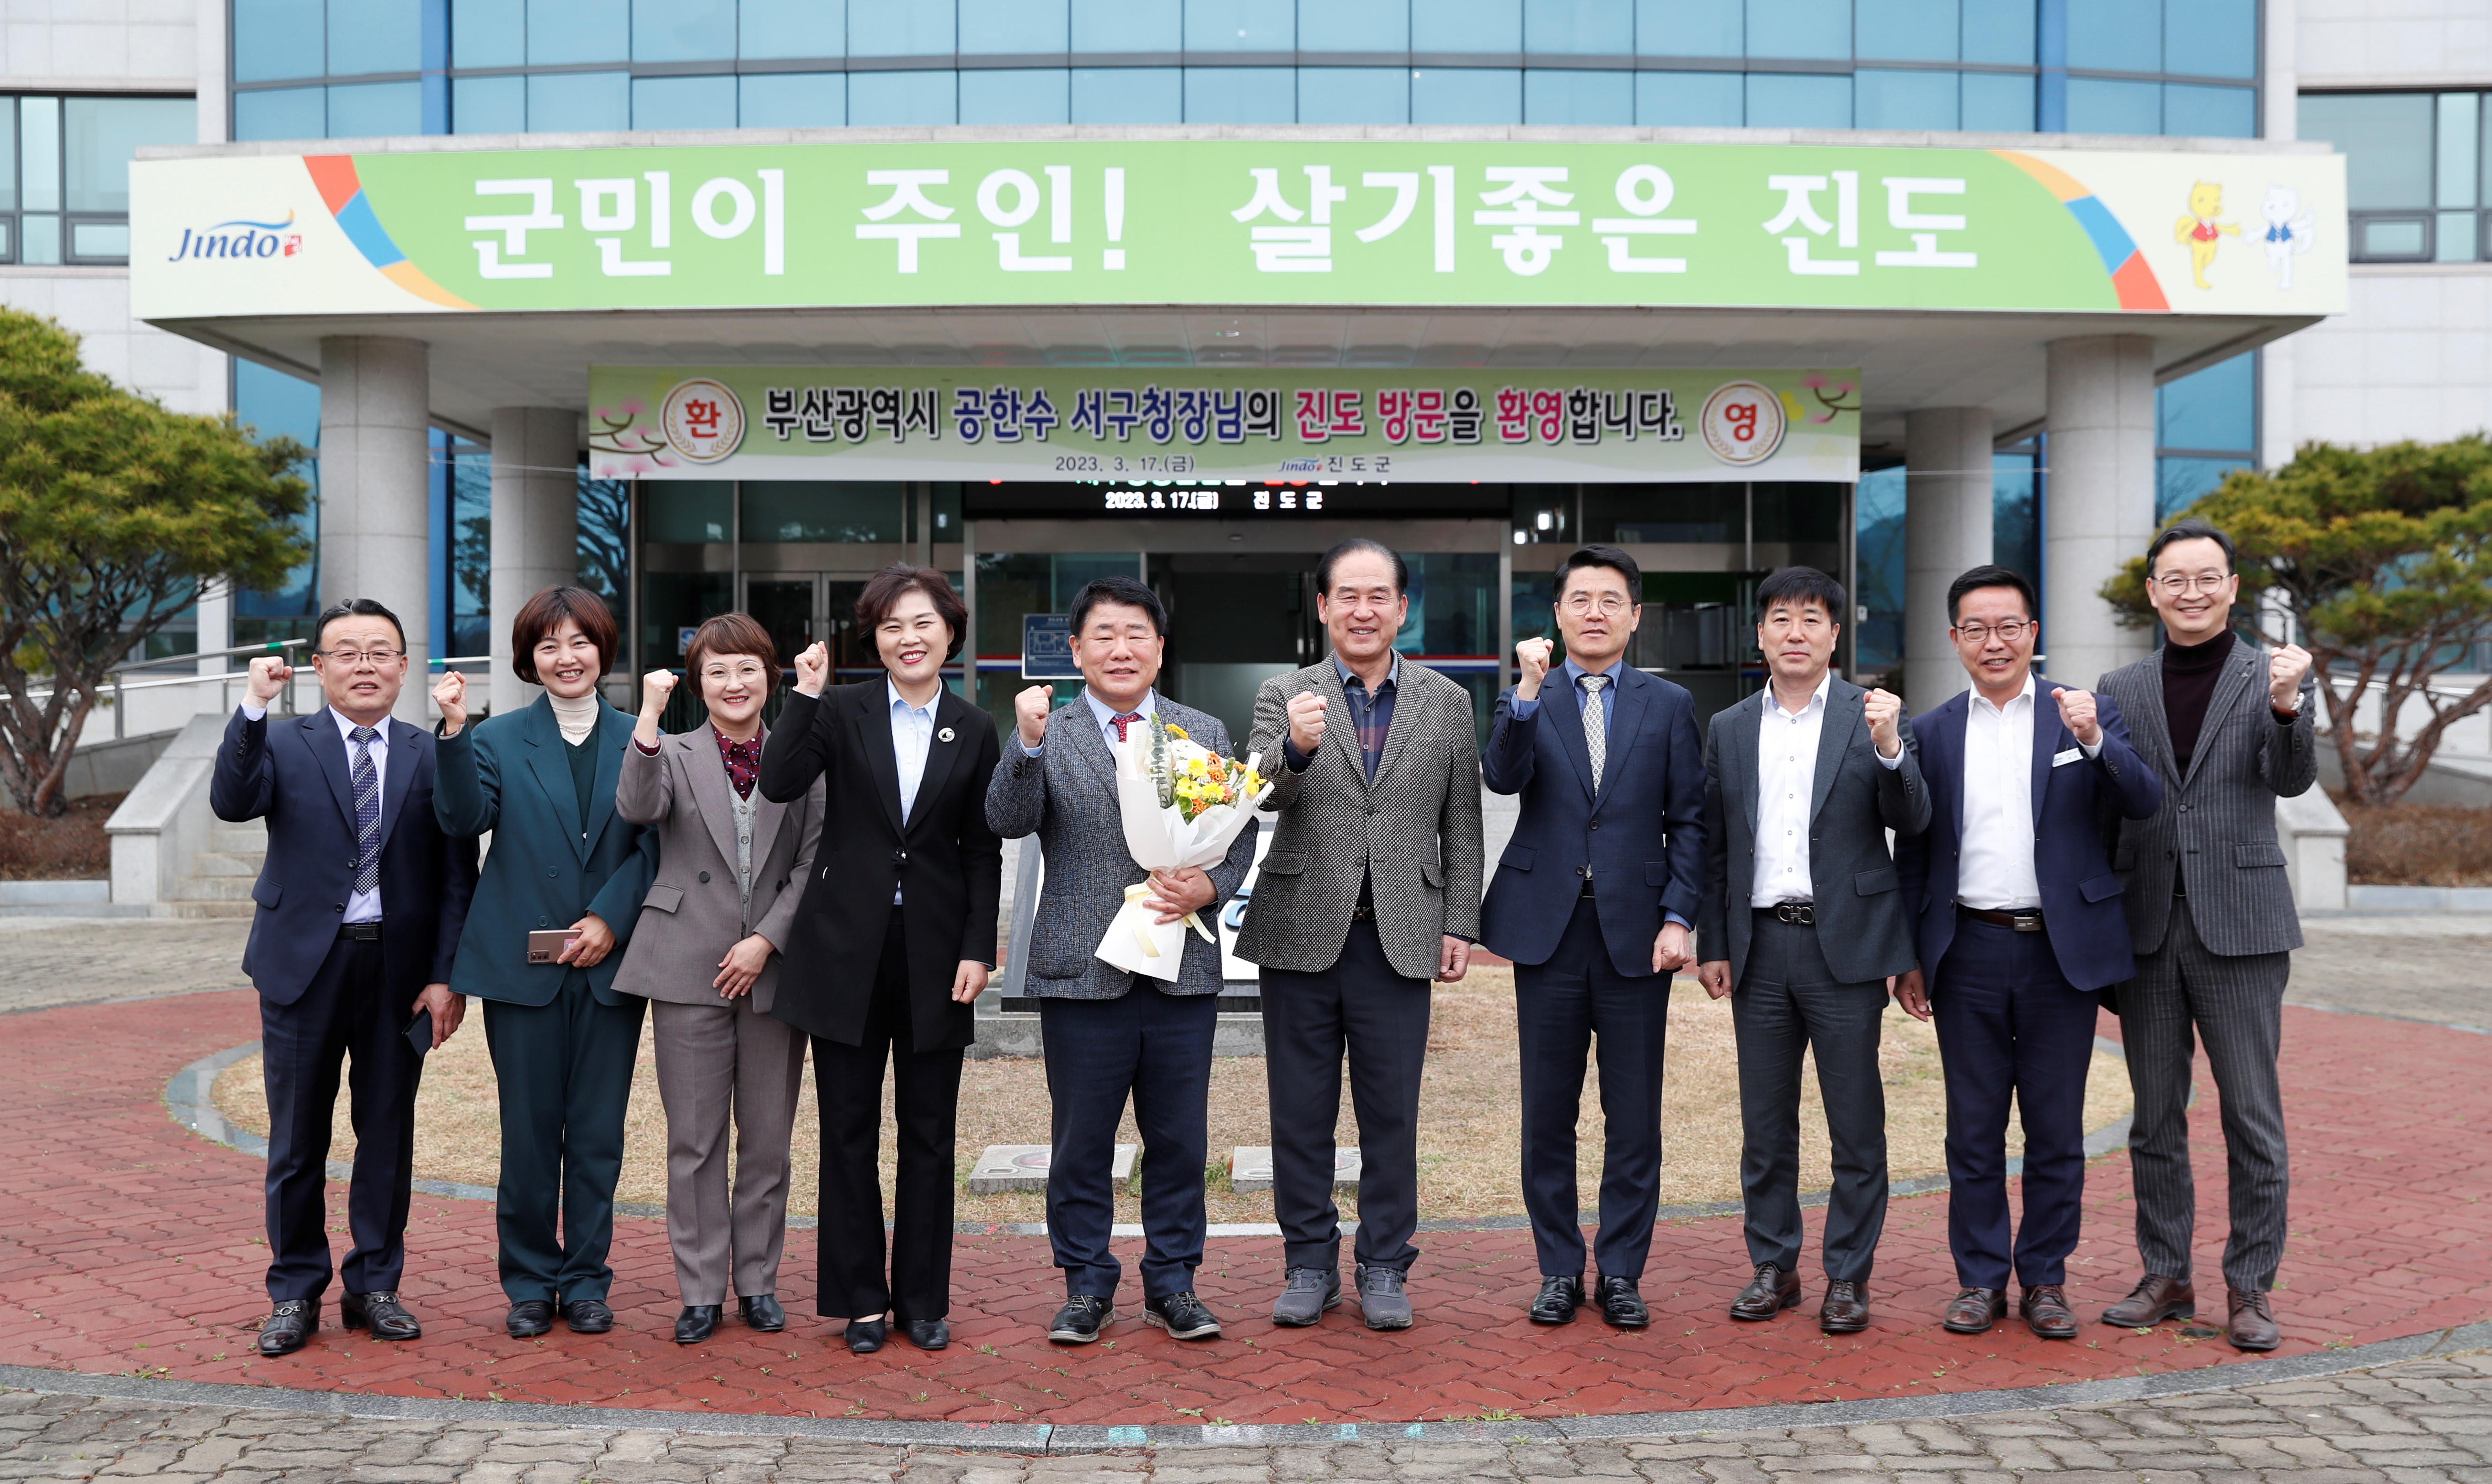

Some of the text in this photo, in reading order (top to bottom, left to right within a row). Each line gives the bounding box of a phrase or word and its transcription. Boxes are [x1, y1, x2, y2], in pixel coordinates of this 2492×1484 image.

[465, 164, 1978, 279] 군민이 주인! 살기좋은 진도
[168, 229, 279, 261] Jindo
[684, 399, 722, 438] 환
[766, 387, 1679, 441] 부산광역시 공한수 서구청장님의 진도 방문을 환영합니다.
[1724, 402, 1758, 442] 영
[1055, 456, 1103, 472] 2023.
[1114, 456, 1130, 472] 3.
[1278, 460, 1315, 473] Jindo
[1105, 491, 1147, 510] 2023.
